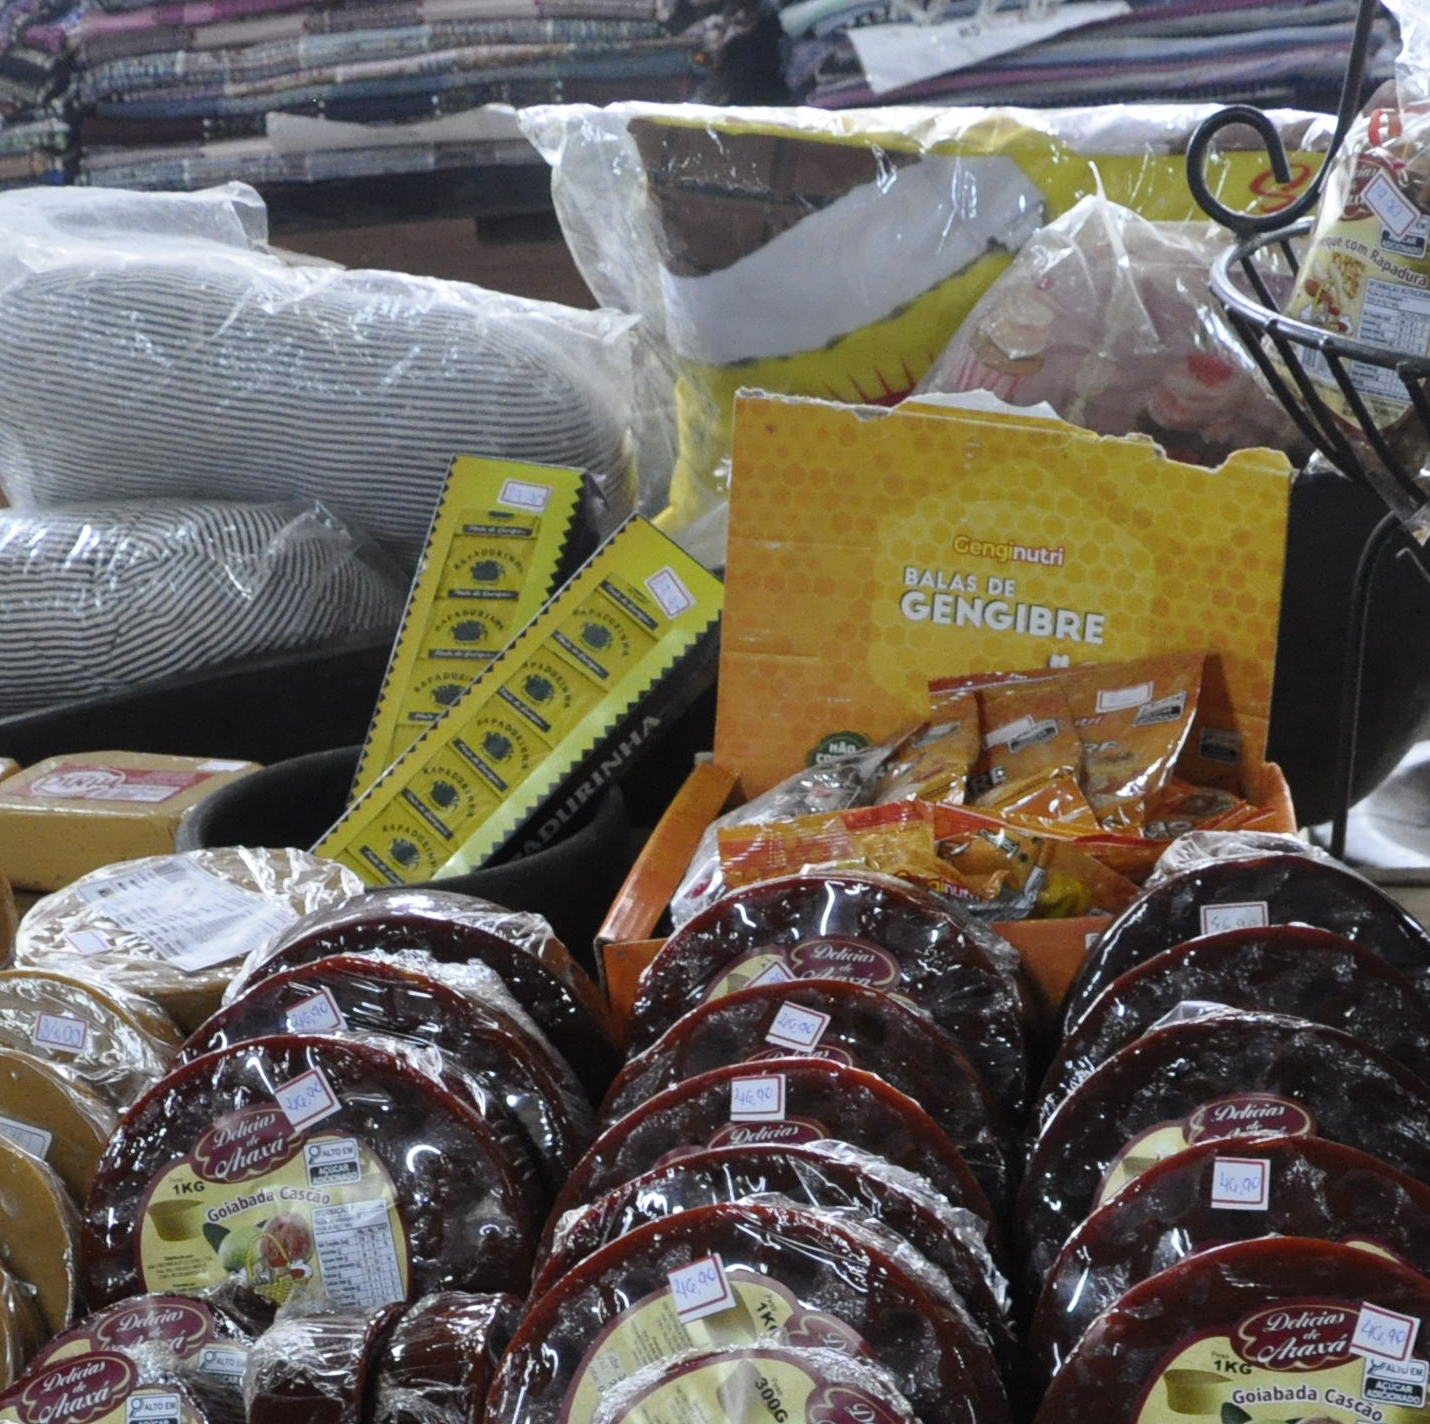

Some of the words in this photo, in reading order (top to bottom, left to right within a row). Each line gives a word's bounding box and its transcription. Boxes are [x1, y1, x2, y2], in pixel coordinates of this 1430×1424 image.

[1345, 237, 1368, 254] com
[1371, 249, 1428, 287] Rapadura
[952, 535, 1065, 568] Genginutri
[903, 567, 977, 593] BALAS
[988, 572, 1016, 598] DE
[899, 591, 1106, 645] GENGIBRE
[1214, 1104, 1285, 1123] Delícias
[729, 1124, 799, 1144] Delícias
[214, 1132, 285, 1179] Araxá
[172, 1181, 205, 1194] 1KG
[207, 1189, 274, 1223] Goiabada
[279, 1186, 330, 1204] Cascão
[1267, 1310, 1345, 1334] Delícias
[1257, 1336, 1349, 1362] Araxá
[41, 1361, 108, 1392] Delícias
[1212, 1359, 1253, 1376] 1KG
[754, 1377, 789, 1424] 300G
[1374, 1379, 1414, 1393] AÇÚCAR
[1232, 1385, 1318, 1405] Goiabada
[1324, 1388, 1384, 1422] Cascão
